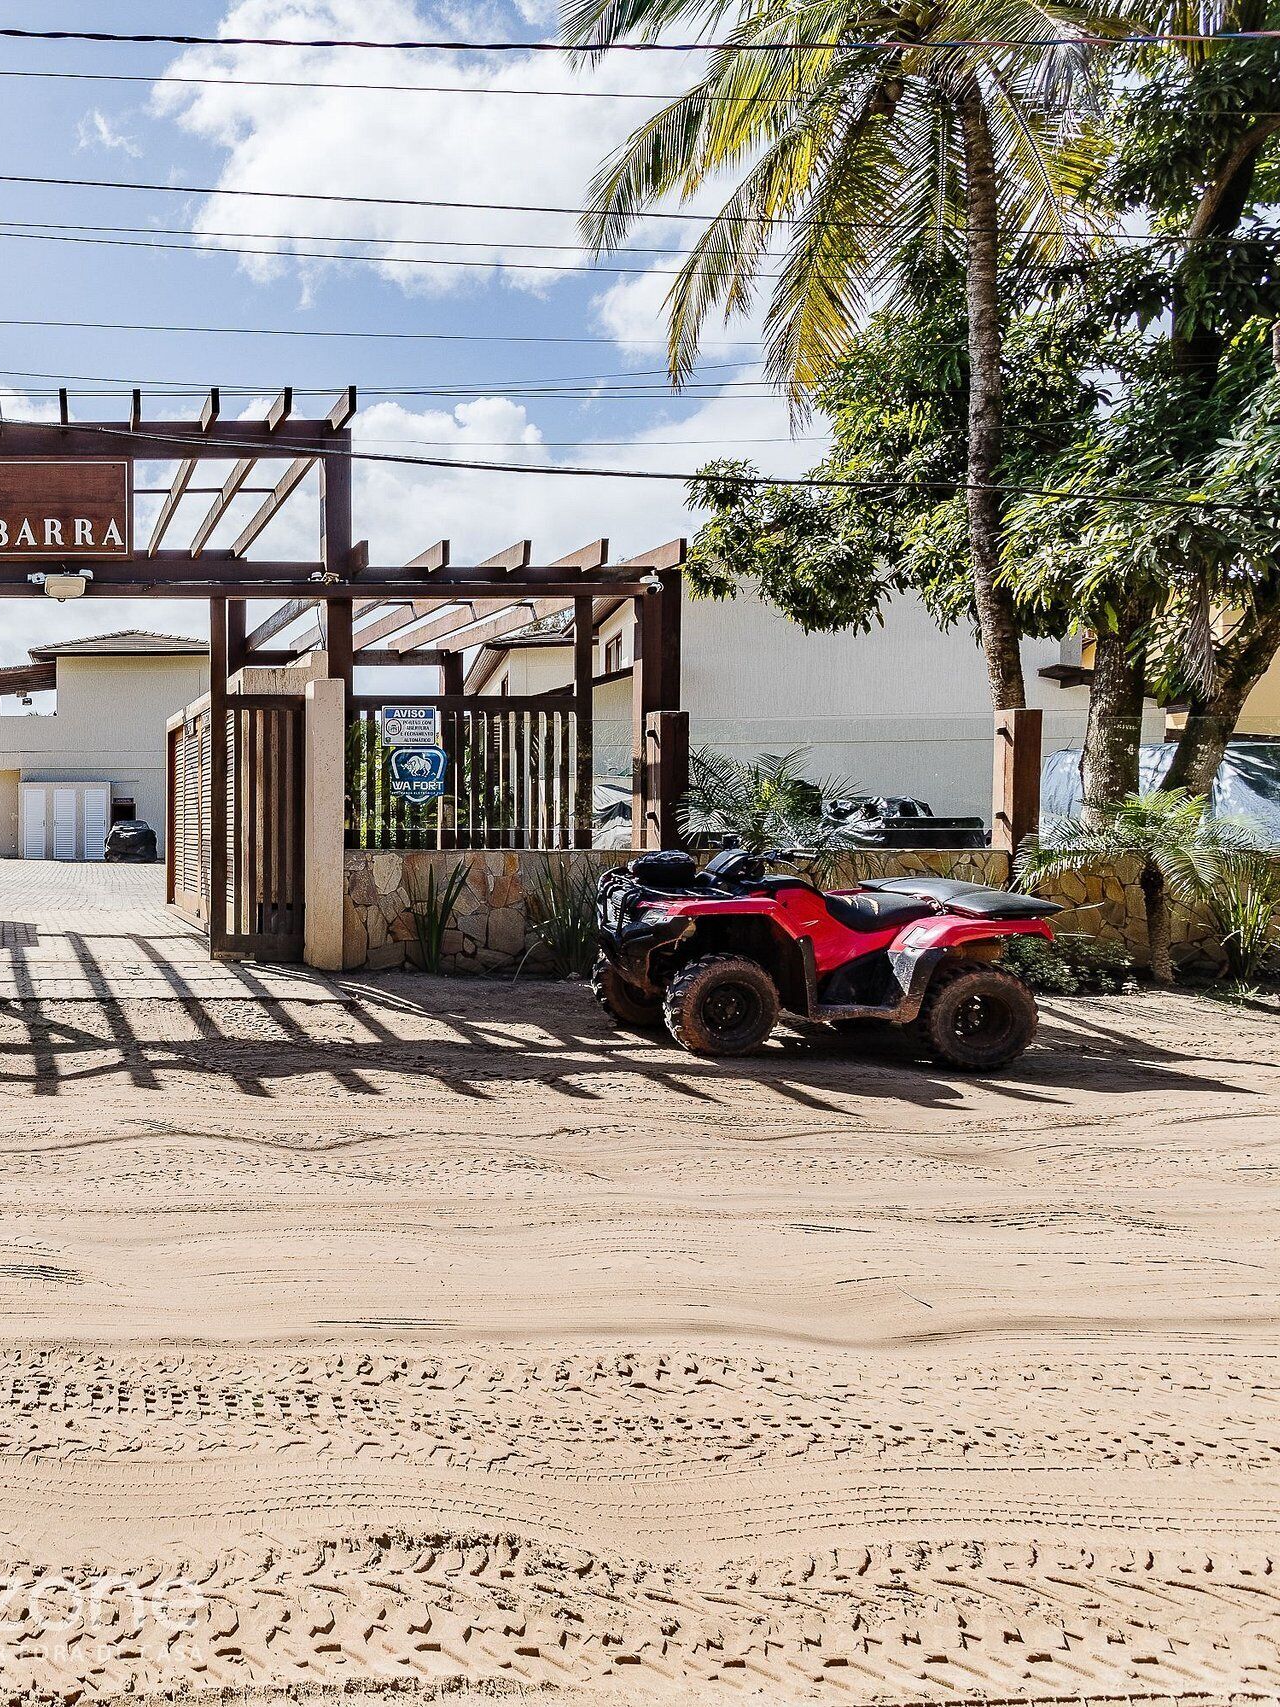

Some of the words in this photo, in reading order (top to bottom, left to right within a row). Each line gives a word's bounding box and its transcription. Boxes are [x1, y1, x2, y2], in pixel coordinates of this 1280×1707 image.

[393, 709, 425, 718] AVISO
[392, 781, 412, 790] WA
[413, 781, 443, 790] FORT
